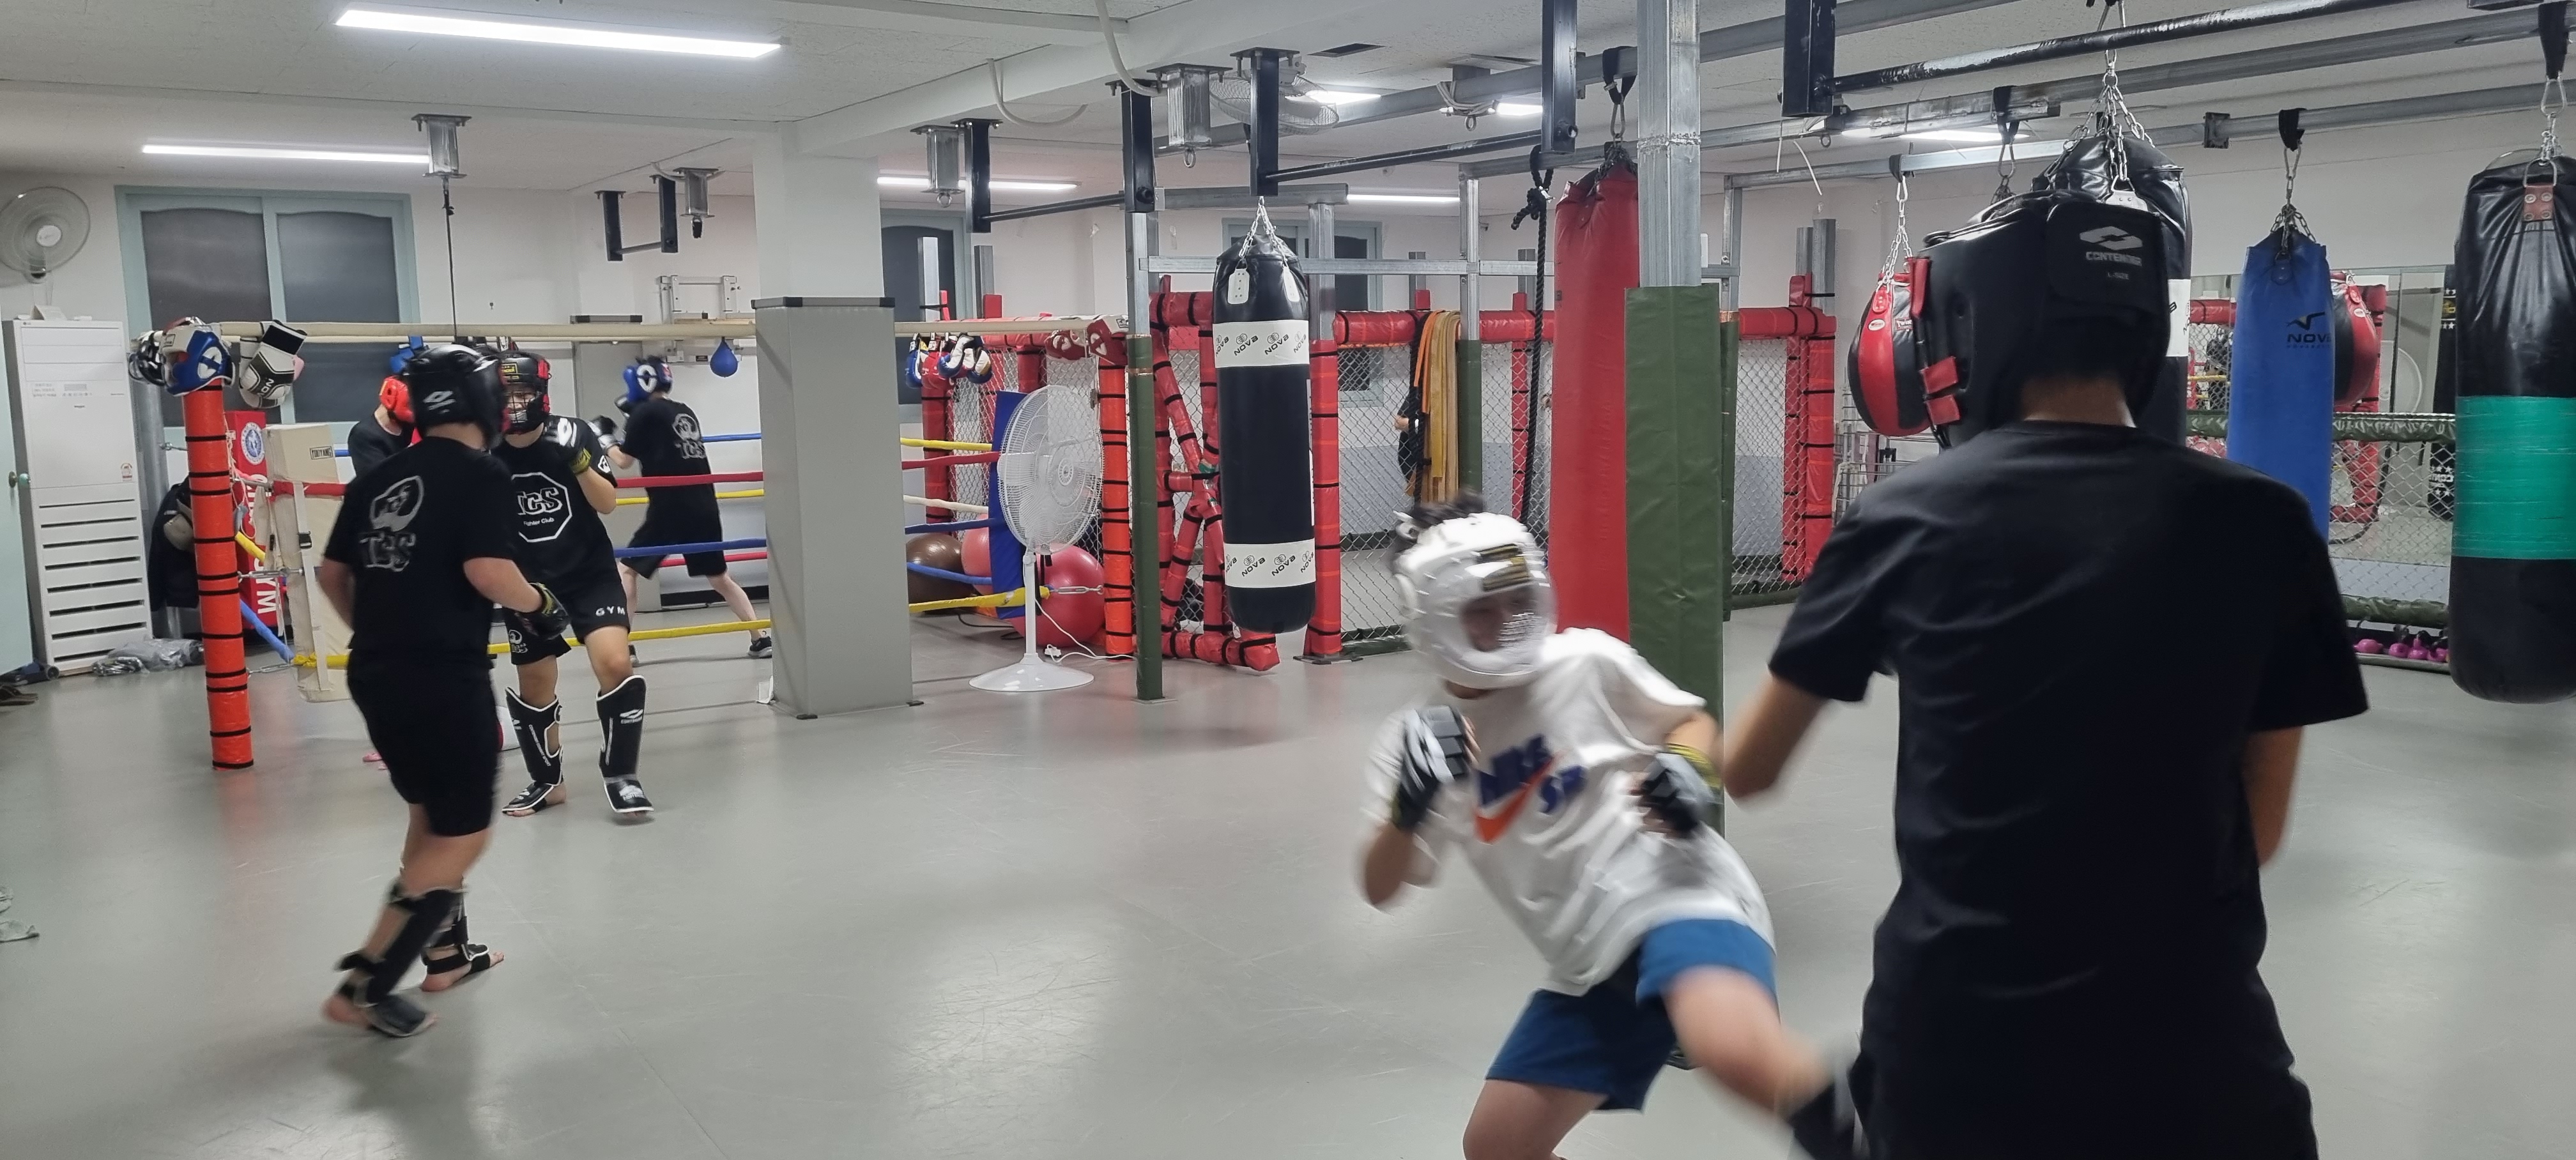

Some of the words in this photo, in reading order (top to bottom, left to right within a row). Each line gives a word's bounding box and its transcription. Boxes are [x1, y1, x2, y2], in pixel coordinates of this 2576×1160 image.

[1234, 335, 1259, 356] NOVA
[1264, 334, 1289, 355] NOVA
[1241, 557, 1266, 577] NOVA
[1271, 554, 1296, 576] NOVA
